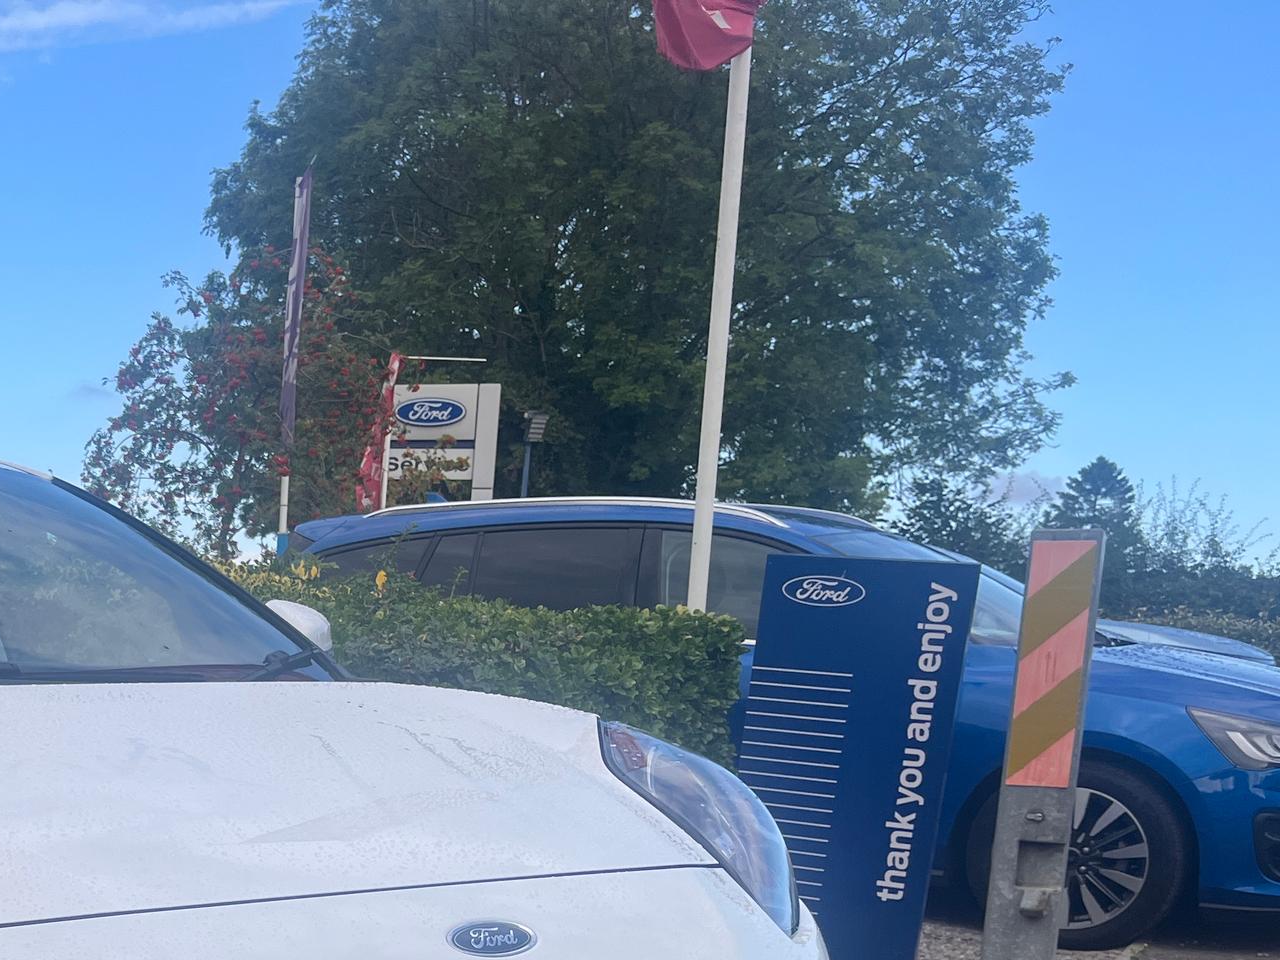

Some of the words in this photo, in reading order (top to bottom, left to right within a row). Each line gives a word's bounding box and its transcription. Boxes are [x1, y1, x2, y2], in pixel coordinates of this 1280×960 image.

[408, 402, 453, 421] Ford
[388, 456, 470, 472] Serv
[796, 579, 852, 602] Ford
[917, 582, 958, 673] enjoy
[907, 678, 938, 742] and
[896, 748, 926, 806] you
[876, 811, 916, 902] thank
[469, 926, 518, 949] Ford
